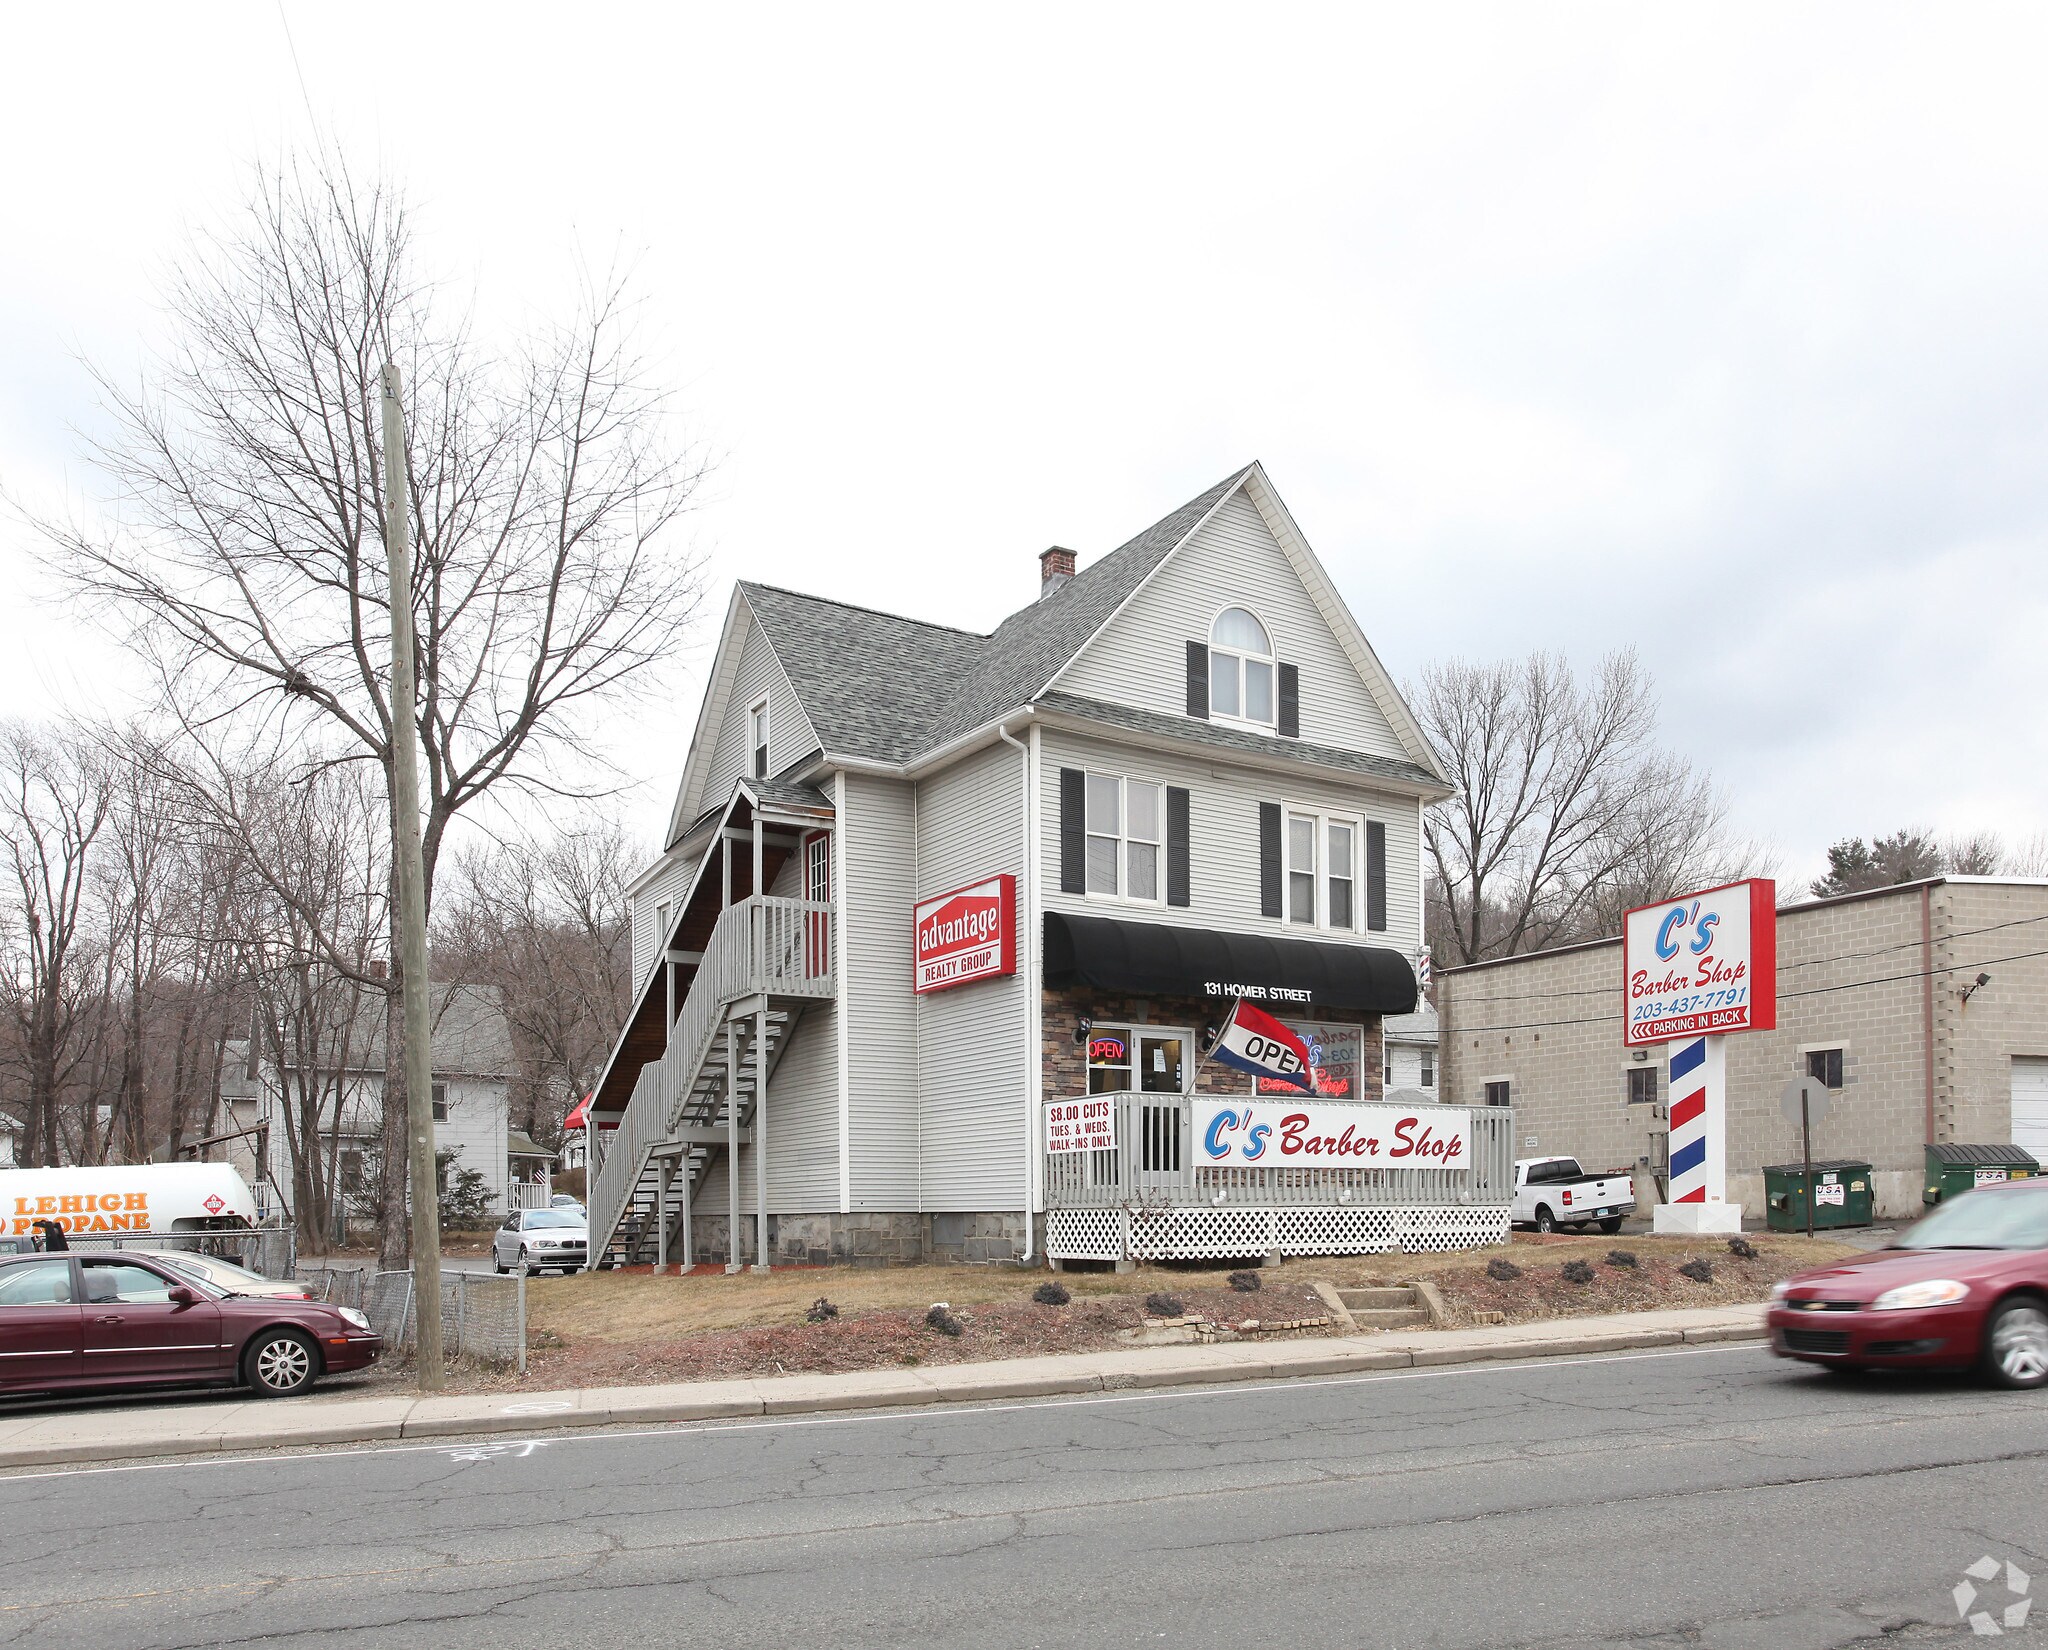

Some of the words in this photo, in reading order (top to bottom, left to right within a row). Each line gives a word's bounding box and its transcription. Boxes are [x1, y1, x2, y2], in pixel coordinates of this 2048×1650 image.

[921, 907, 997, 952] advantage
[1654, 900, 1720, 963] C's
[925, 960, 957, 981] REALTY
[961, 951, 991, 972] GROUP
[1631, 969, 1689, 998] Barber
[1695, 955, 1746, 986] Shop
[1204, 982, 1221, 995] 131
[1224, 983, 1267, 998] HOMER
[1269, 987, 1312, 1002] STREET
[1633, 987, 1747, 1020] 203-437-7791
[1653, 1016, 1695, 1035] PARKING
[1698, 1015, 1708, 1027] IN
[1712, 1010, 1741, 1025] BACK
[1089, 1041, 1123, 1058] OPEN
[1050, 1105, 1078, 1122] $8.00
[1083, 1102, 1109, 1118] CUTS
[1050, 1125, 1072, 1137] TUES.
[1075, 1124, 1081, 1134] &
[1085, 1121, 1110, 1133] WEDS.
[1203, 1107, 1272, 1161] C's
[1280, 1113, 1380, 1156] Barber
[1389, 1117, 1463, 1165] Shop
[1049, 1137, 1088, 1151] WALK-INS
[1092, 1135, 1111, 1148] ONLY
[14, 1193, 148, 1215] LEHIGH
